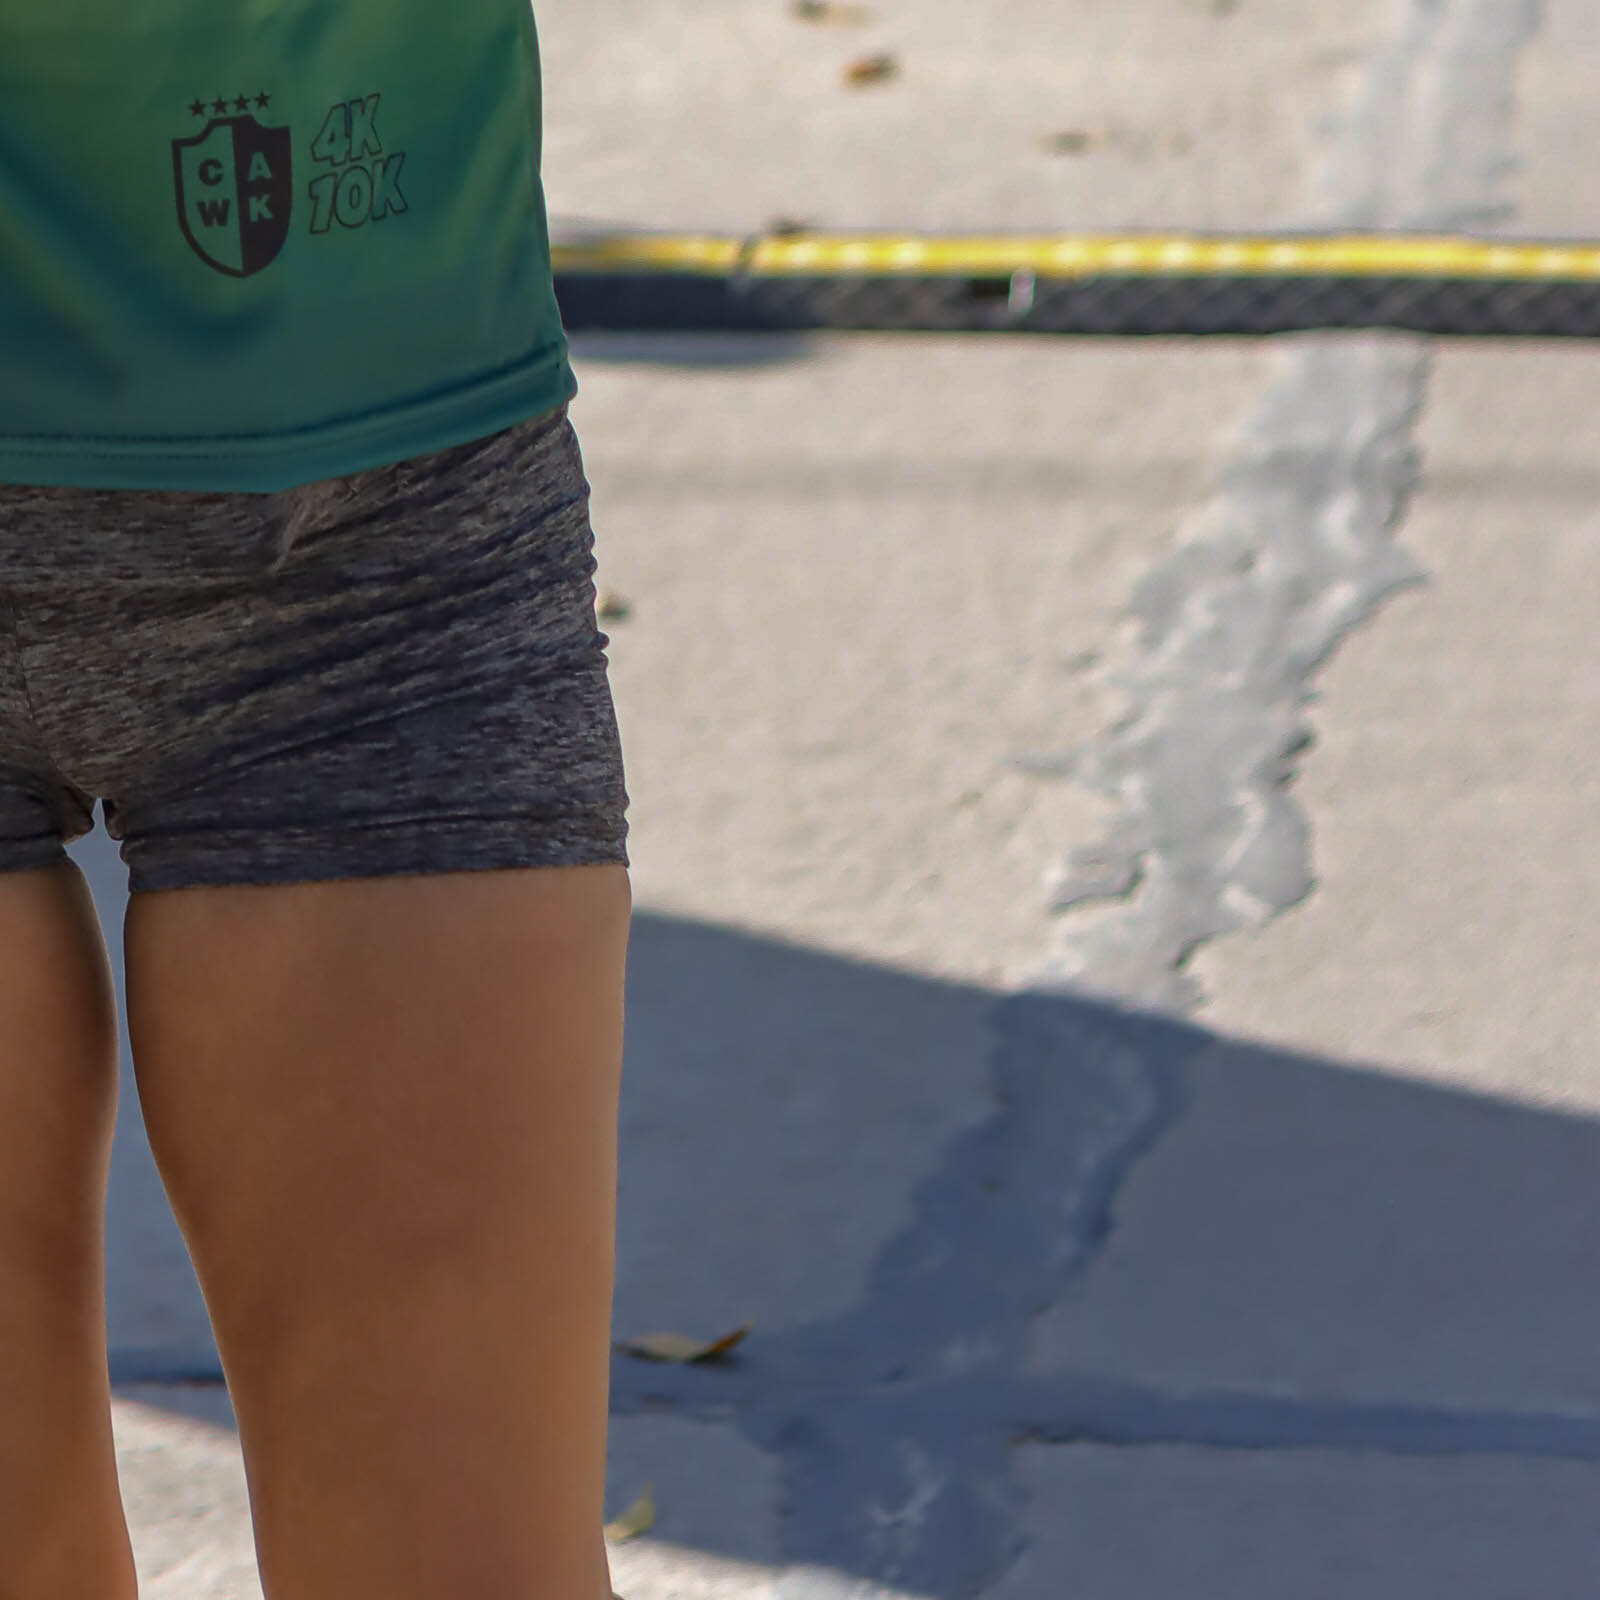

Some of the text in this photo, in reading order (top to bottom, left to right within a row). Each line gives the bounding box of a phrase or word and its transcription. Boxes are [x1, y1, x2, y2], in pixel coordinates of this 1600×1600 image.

[309, 91, 383, 168] 4K
[198, 151, 273, 188] C A
[307, 151, 409, 235] 10K
[197, 193, 274, 228] W K
